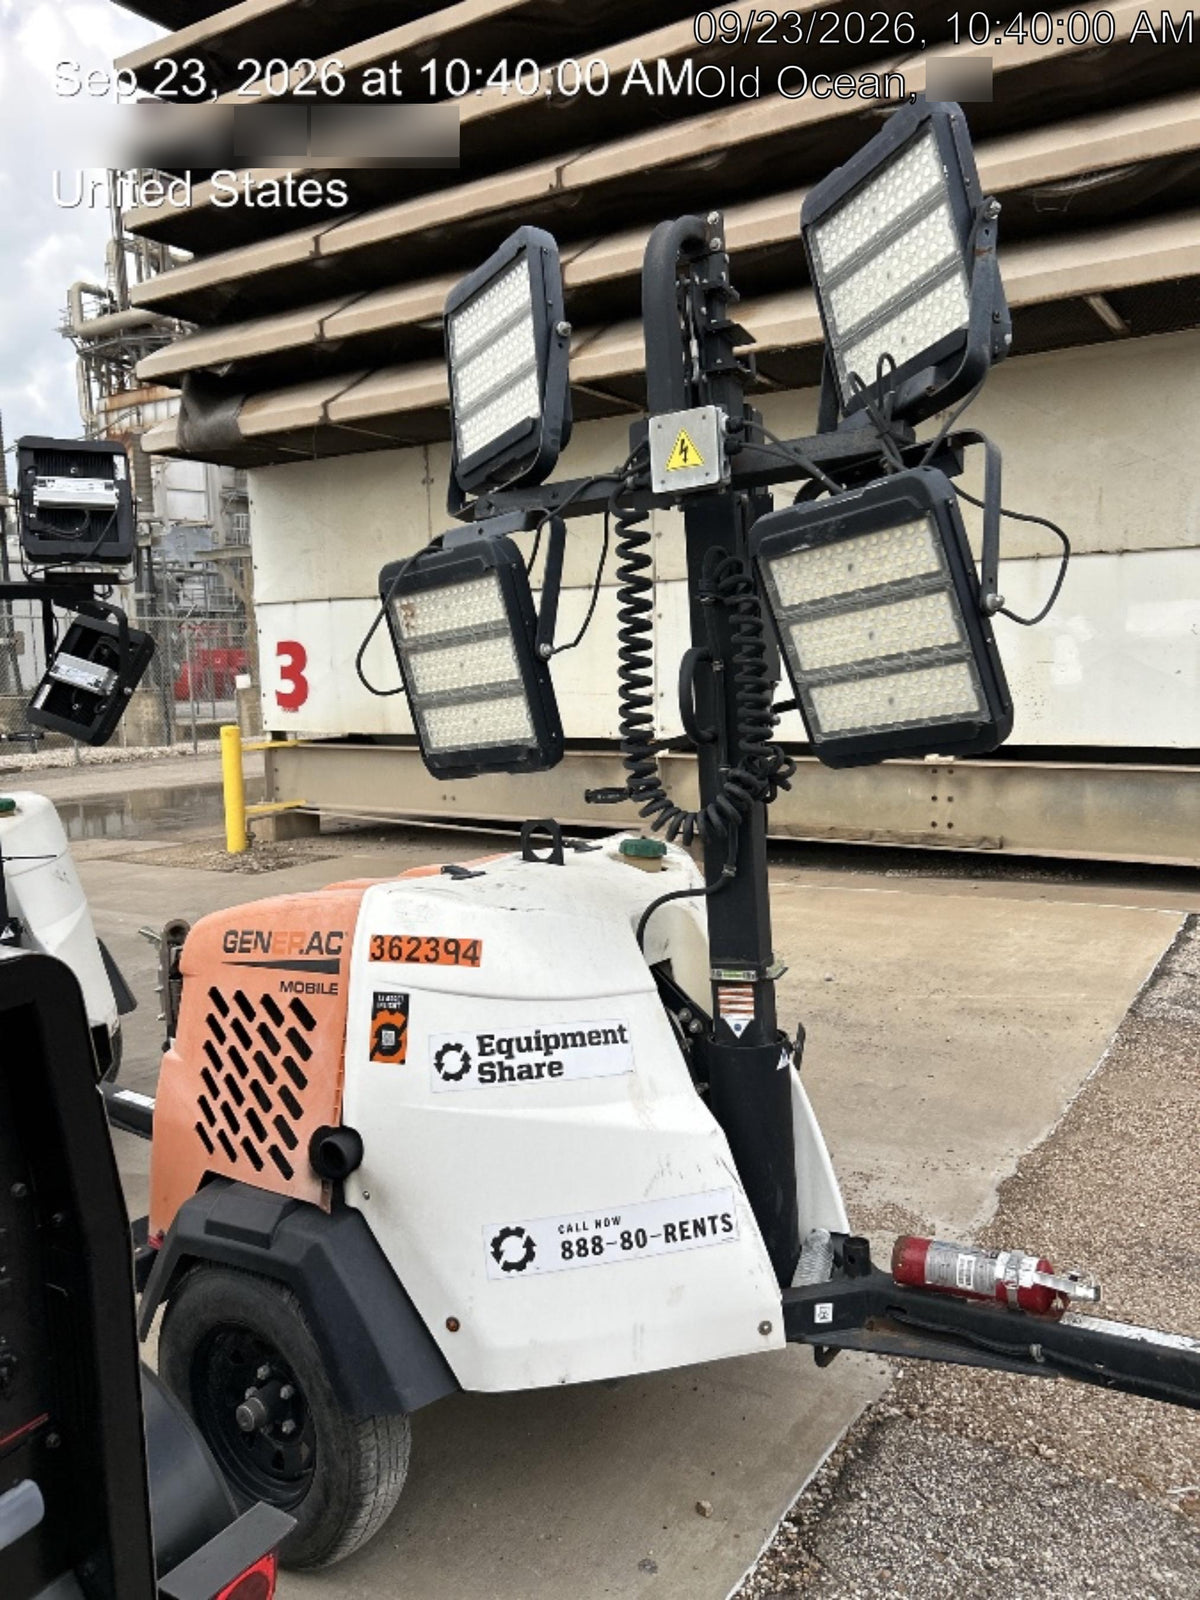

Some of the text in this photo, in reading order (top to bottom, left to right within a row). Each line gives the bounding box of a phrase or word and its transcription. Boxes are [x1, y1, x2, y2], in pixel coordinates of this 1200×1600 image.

[274, 639, 309, 713] 3
[222, 929, 344, 955] GENERAC
[370, 935, 481, 966] 362394
[279, 980, 339, 996] MOBILE
[476, 1023, 629, 1060] Equipment
[477, 1059, 564, 1084] Share
[557, 1215, 622, 1235] CALL NOW
[560, 1212, 734, 1261] 888-80-RENTS
